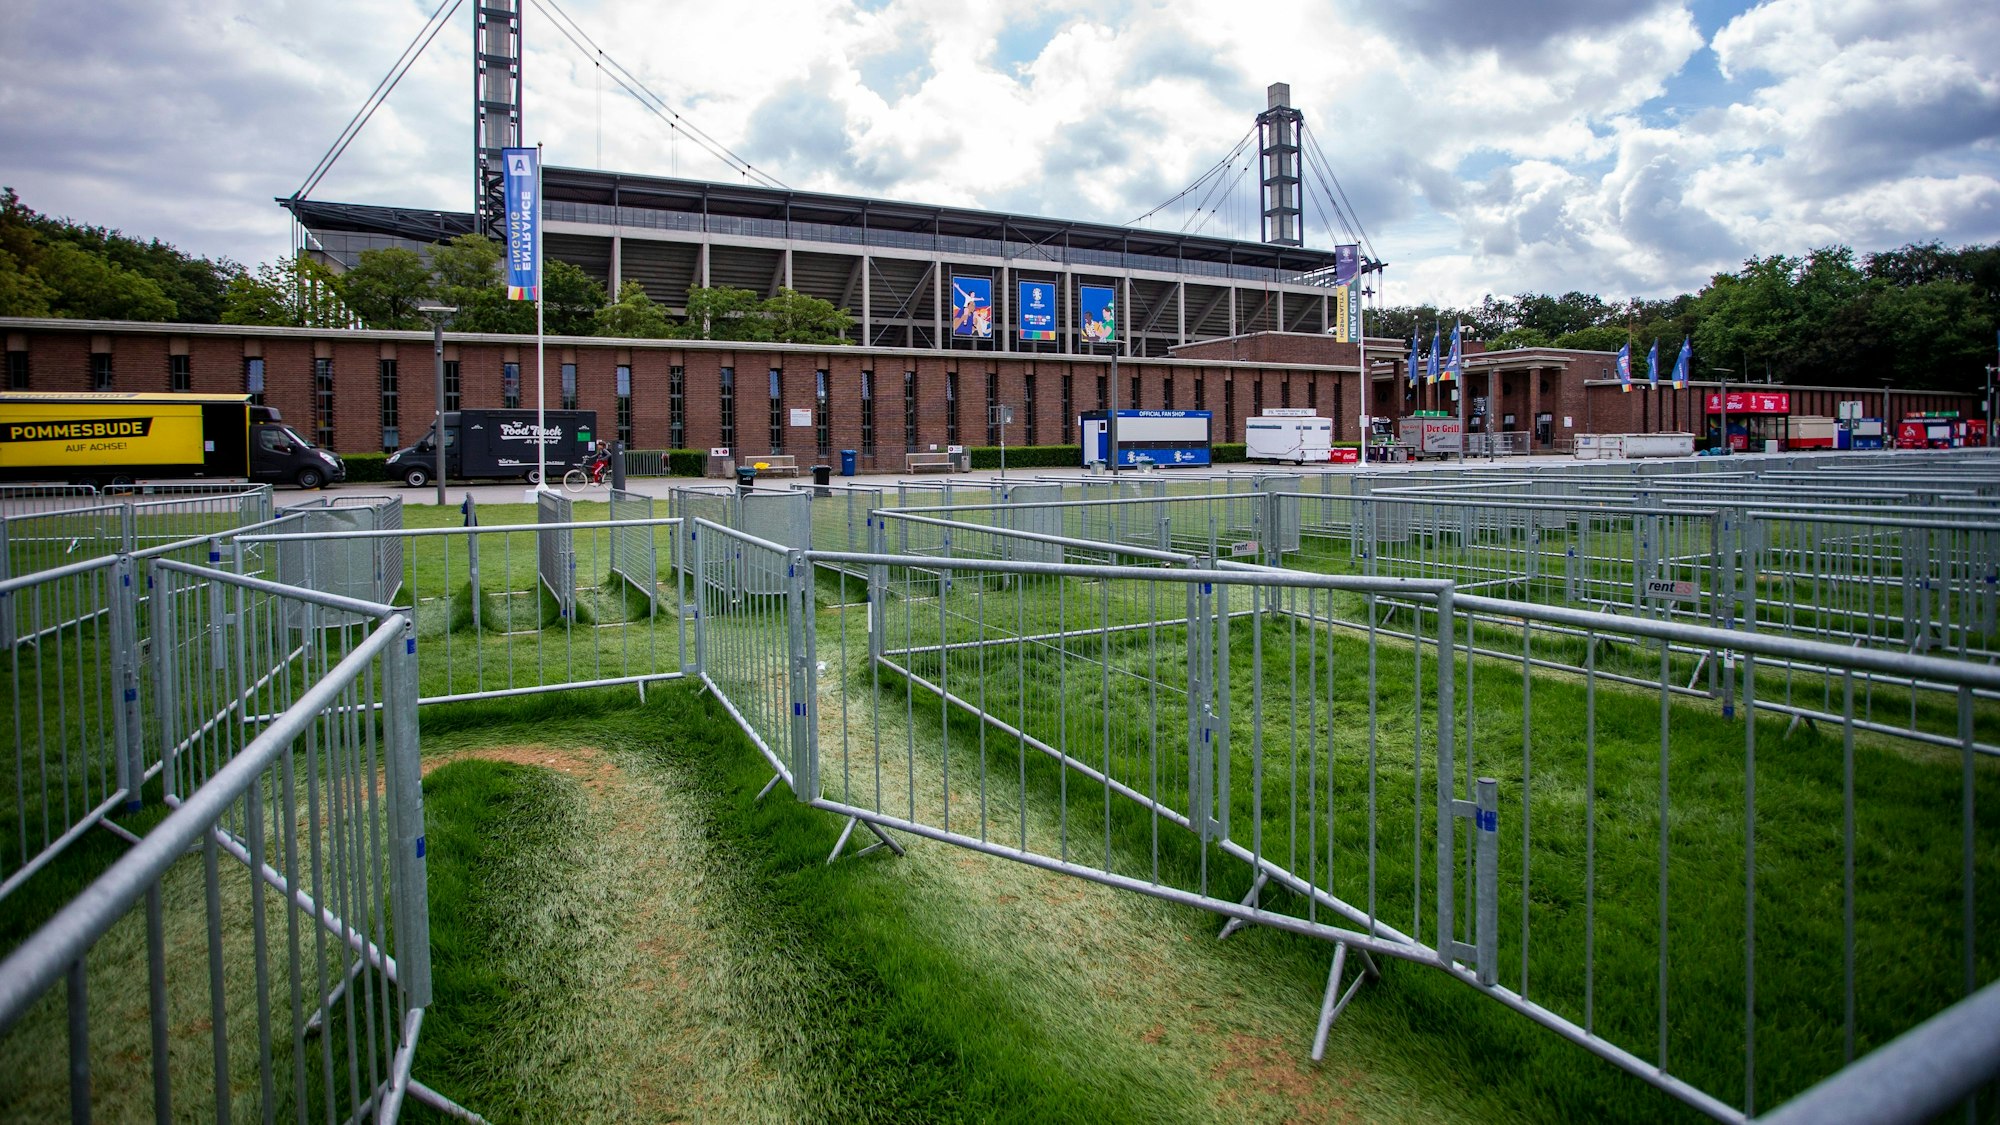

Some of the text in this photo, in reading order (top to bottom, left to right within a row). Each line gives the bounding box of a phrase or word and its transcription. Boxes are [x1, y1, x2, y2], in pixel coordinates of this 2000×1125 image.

[514, 160, 525, 171] A
[10, 421, 144, 440] POMMESBUDE
[500, 424, 530, 435] Food
[1442, 424, 1460, 432] Grill
[65, 442, 127, 452] AUF ACHSE!
[1648, 582, 1693, 594] rentES
